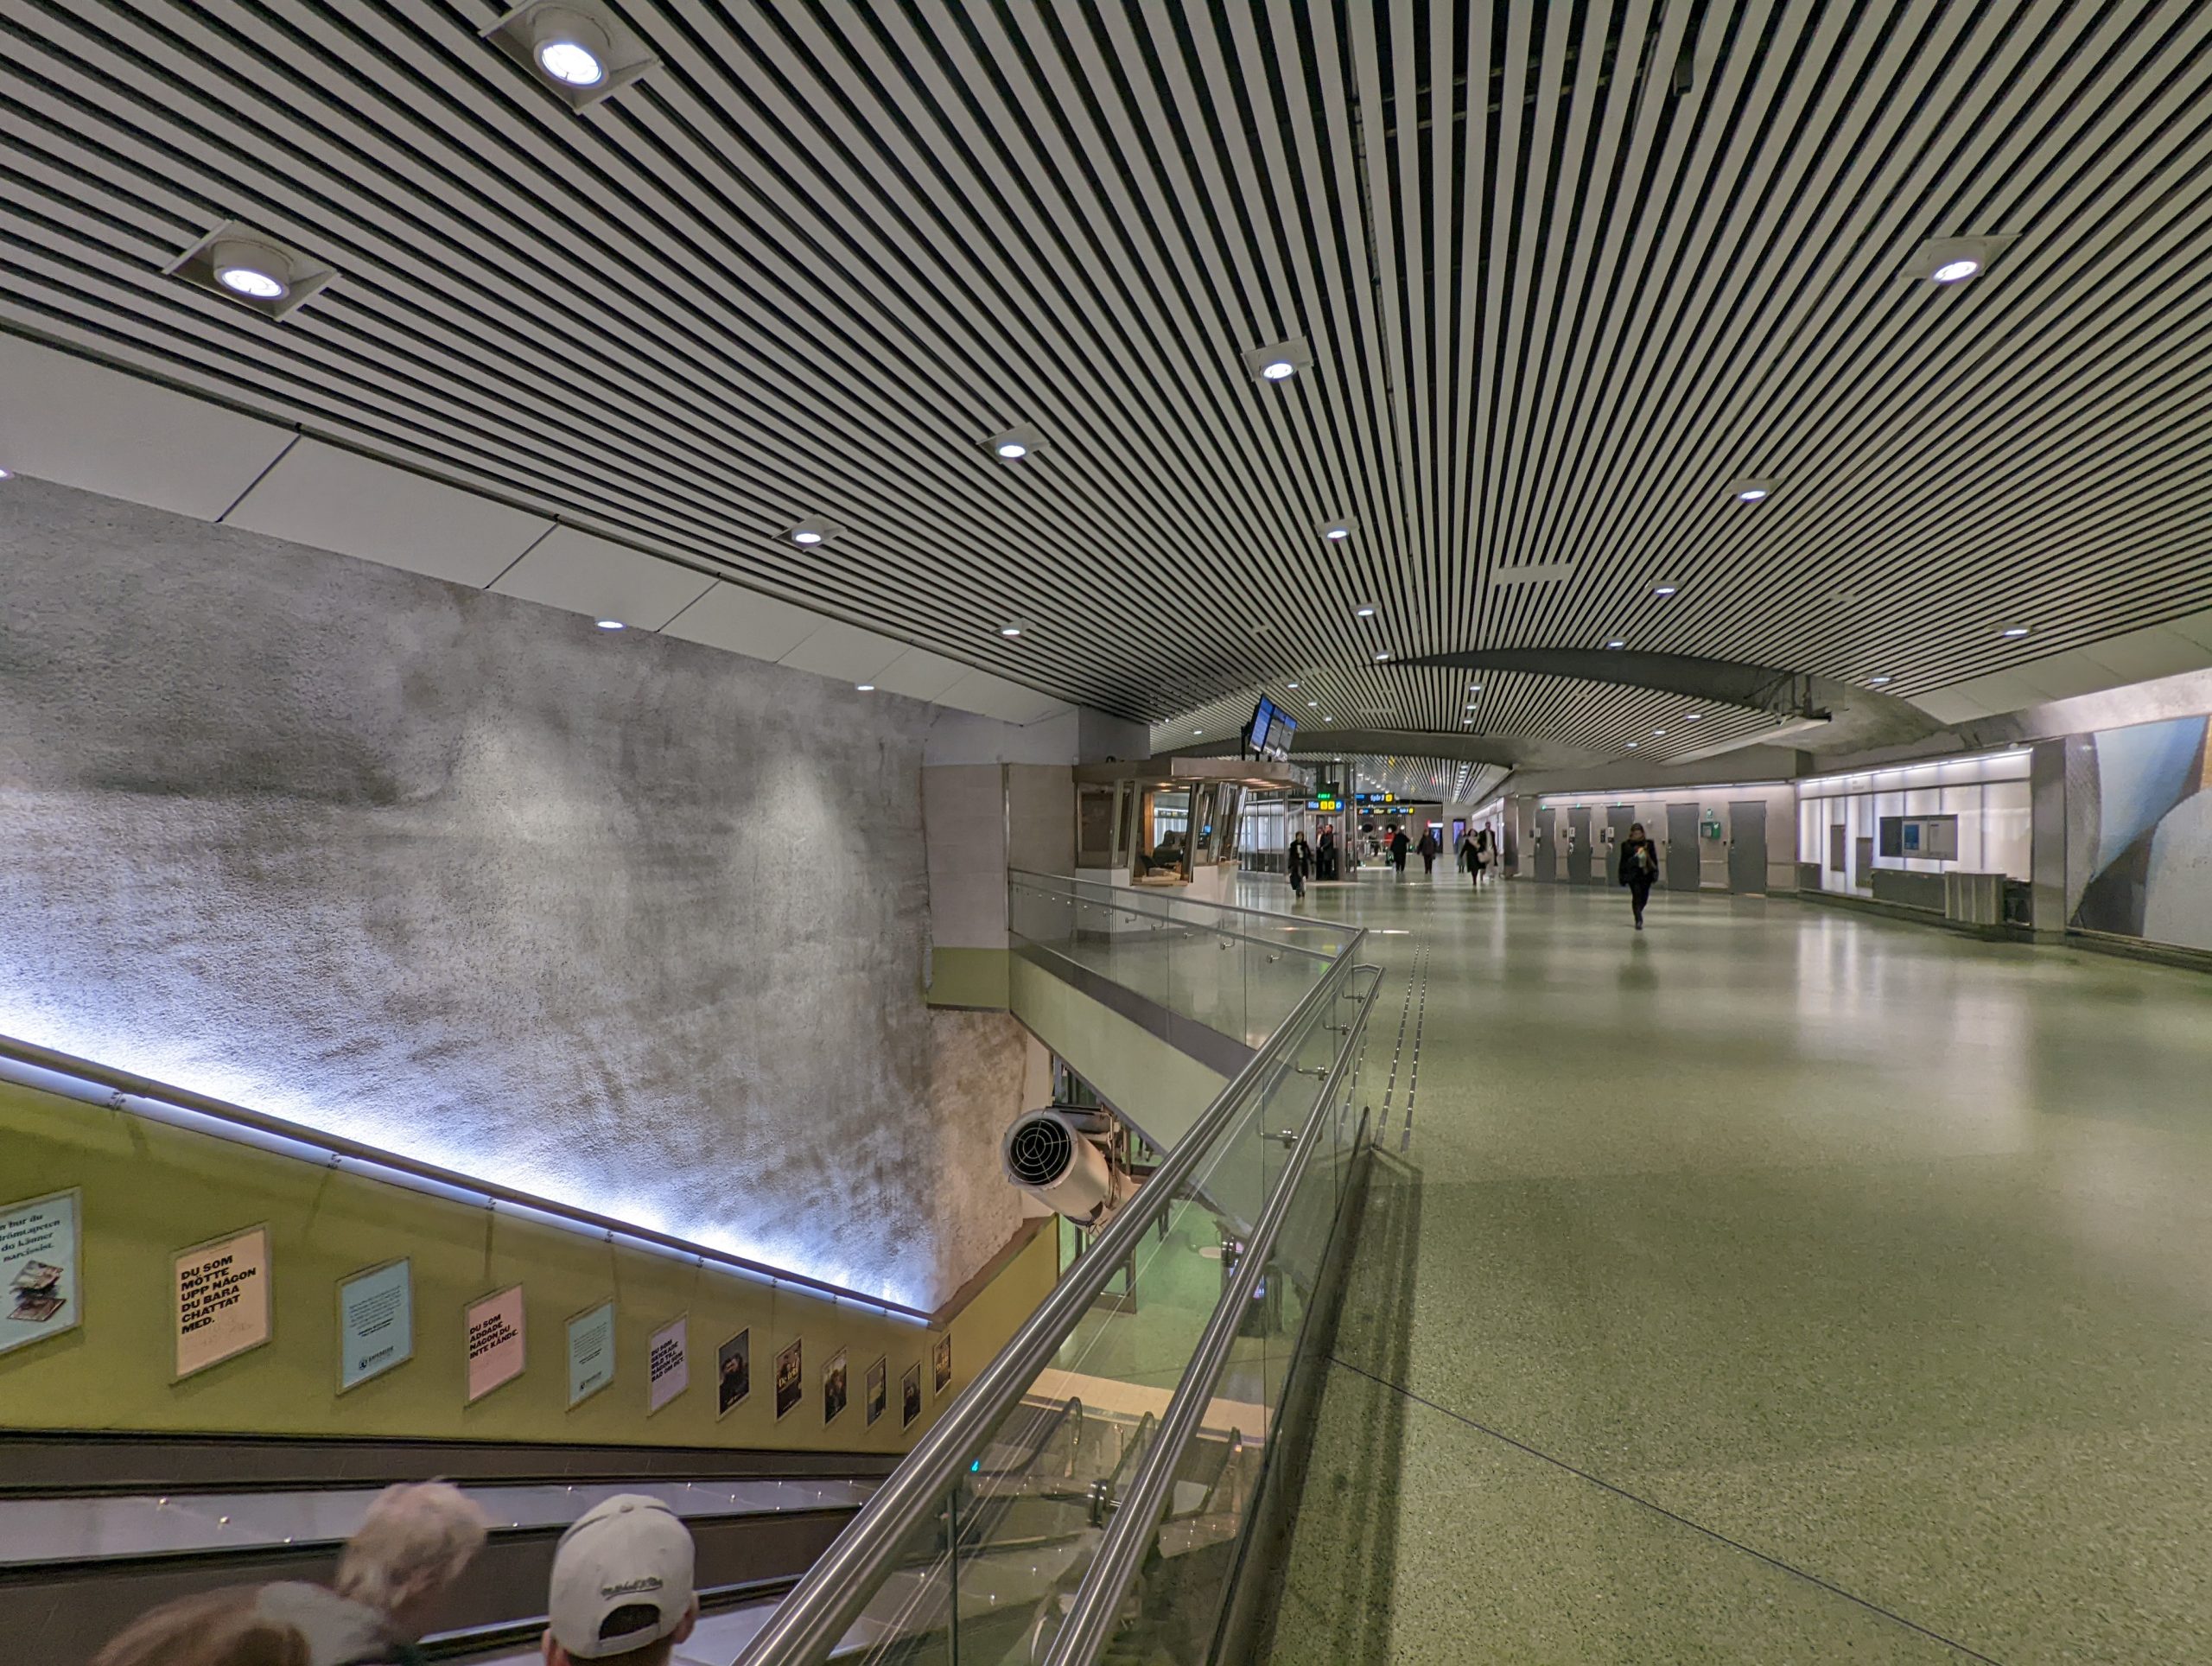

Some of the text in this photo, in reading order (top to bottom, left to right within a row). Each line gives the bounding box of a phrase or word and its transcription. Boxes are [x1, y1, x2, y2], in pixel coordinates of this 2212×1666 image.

[30, 1214, 43, 1223] du
[181, 1255, 233, 1281] DU SOM
[181, 1267, 229, 1292] MÖTTE
[181, 1267, 256, 1301] UPP NÅGON
[181, 1285, 239, 1313] DU BARA
[181, 1294, 240, 1323] CHATTAT
[181, 1316, 215, 1335] MED.
[469, 1313, 501, 1335] DU SOM
[469, 1321, 503, 1344] ADDADE
[499, 1324, 511, 1336] DU
[469, 1345, 489, 1360] INTE
[651, 1339, 672, 1357] DU SOM
